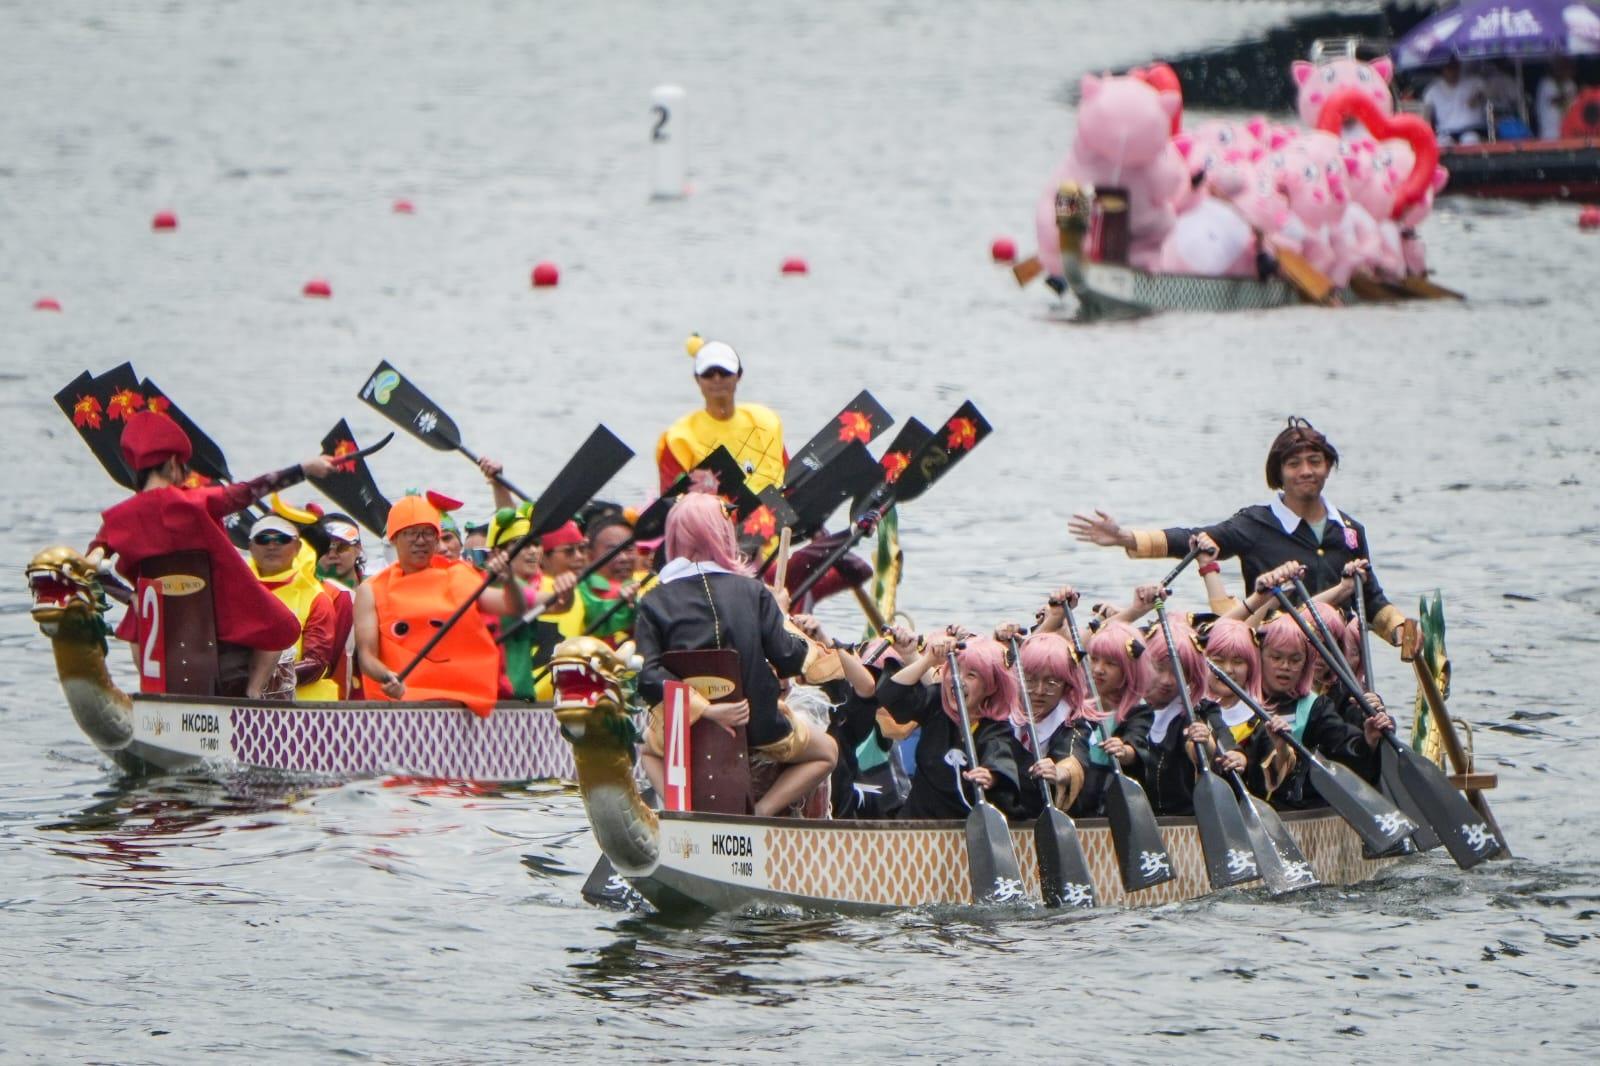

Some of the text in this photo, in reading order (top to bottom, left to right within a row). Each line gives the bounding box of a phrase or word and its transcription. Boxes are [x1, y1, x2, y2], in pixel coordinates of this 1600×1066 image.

[650, 105, 671, 144] 2
[142, 585, 160, 678] 2
[181, 713, 219, 733] HKCDBA
[667, 687, 686, 812] 4
[712, 834, 753, 857] HKCDBA
[731, 862, 752, 877] 17-M09
